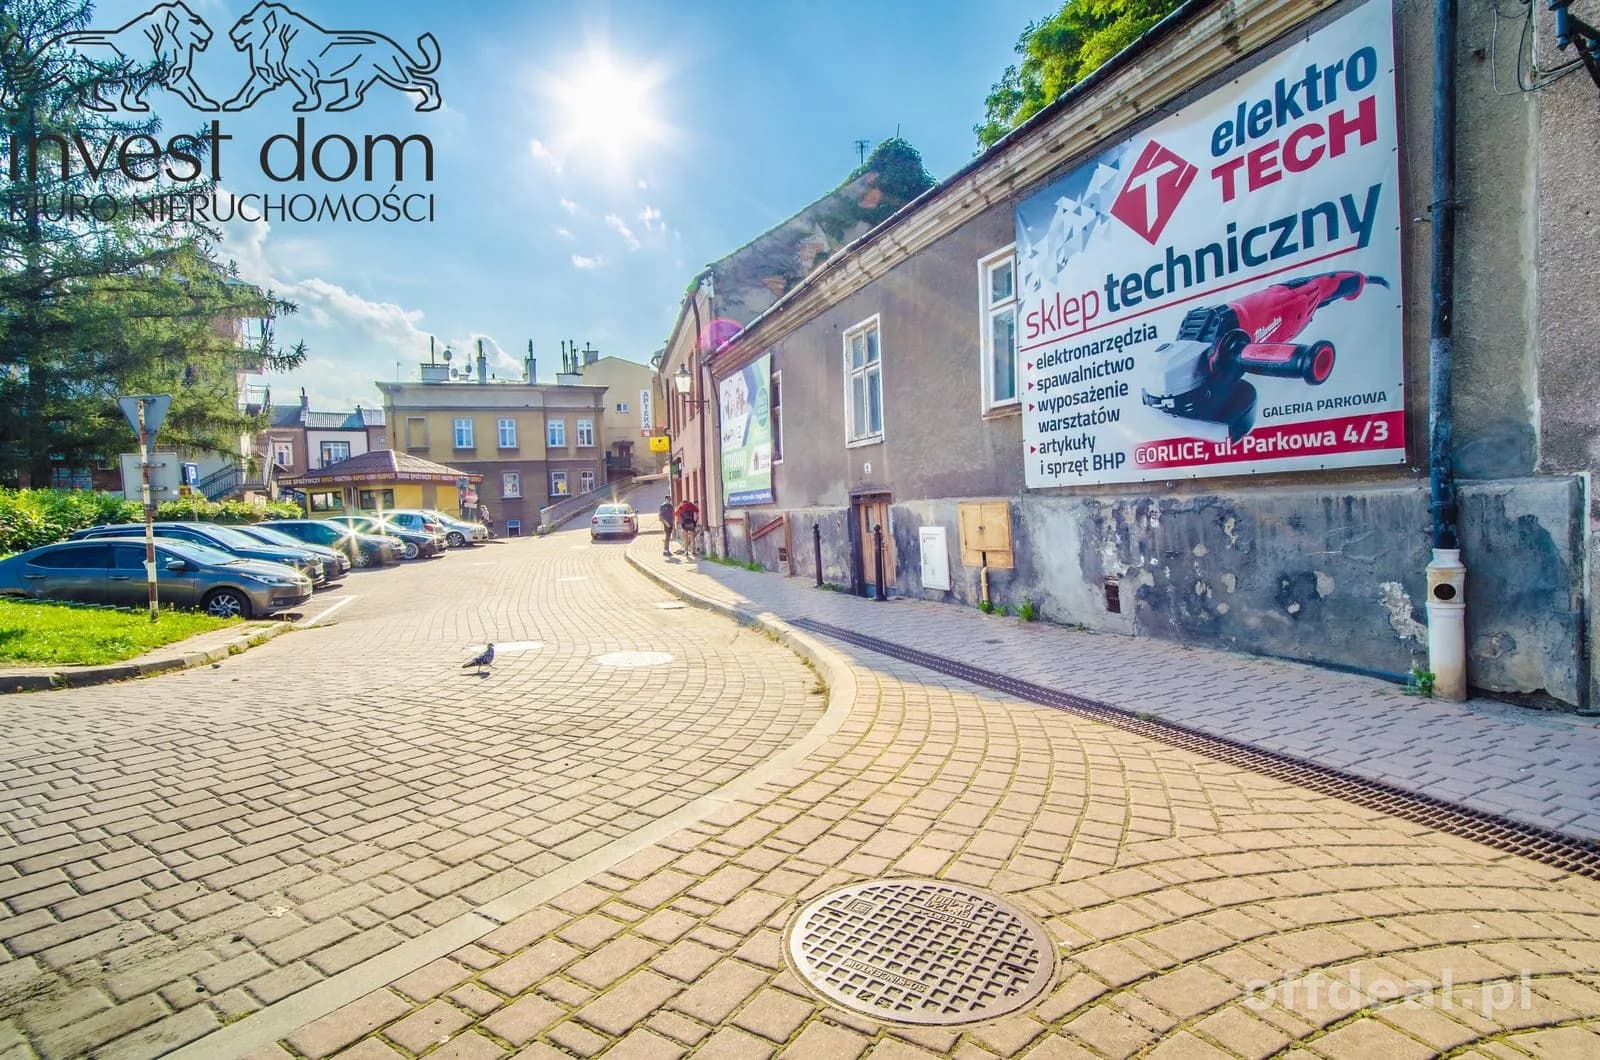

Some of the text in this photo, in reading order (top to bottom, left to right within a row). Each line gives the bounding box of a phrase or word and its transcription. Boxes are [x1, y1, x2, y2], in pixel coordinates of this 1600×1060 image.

[1211, 46, 1378, 157] elektro
[1211, 95, 1378, 203] TECH
[1026, 182, 1383, 340] sklep techniczny
[1036, 323, 1158, 370] elektronarzędzia
[1037, 356, 1135, 394] spawalnictwo
[1037, 380, 1129, 415] wyposażenie
[1263, 391, 1388, 418] GALERIA PARKOWA
[1038, 406, 1120, 433] warsztatów
[1039, 433, 1096, 456] artykuły
[1135, 419, 1389, 464] GORLICE, ul. Parkowa 4/3
[188, 466, 197, 484] P
[1040, 452, 1126, 479] i sprzęt BHP
